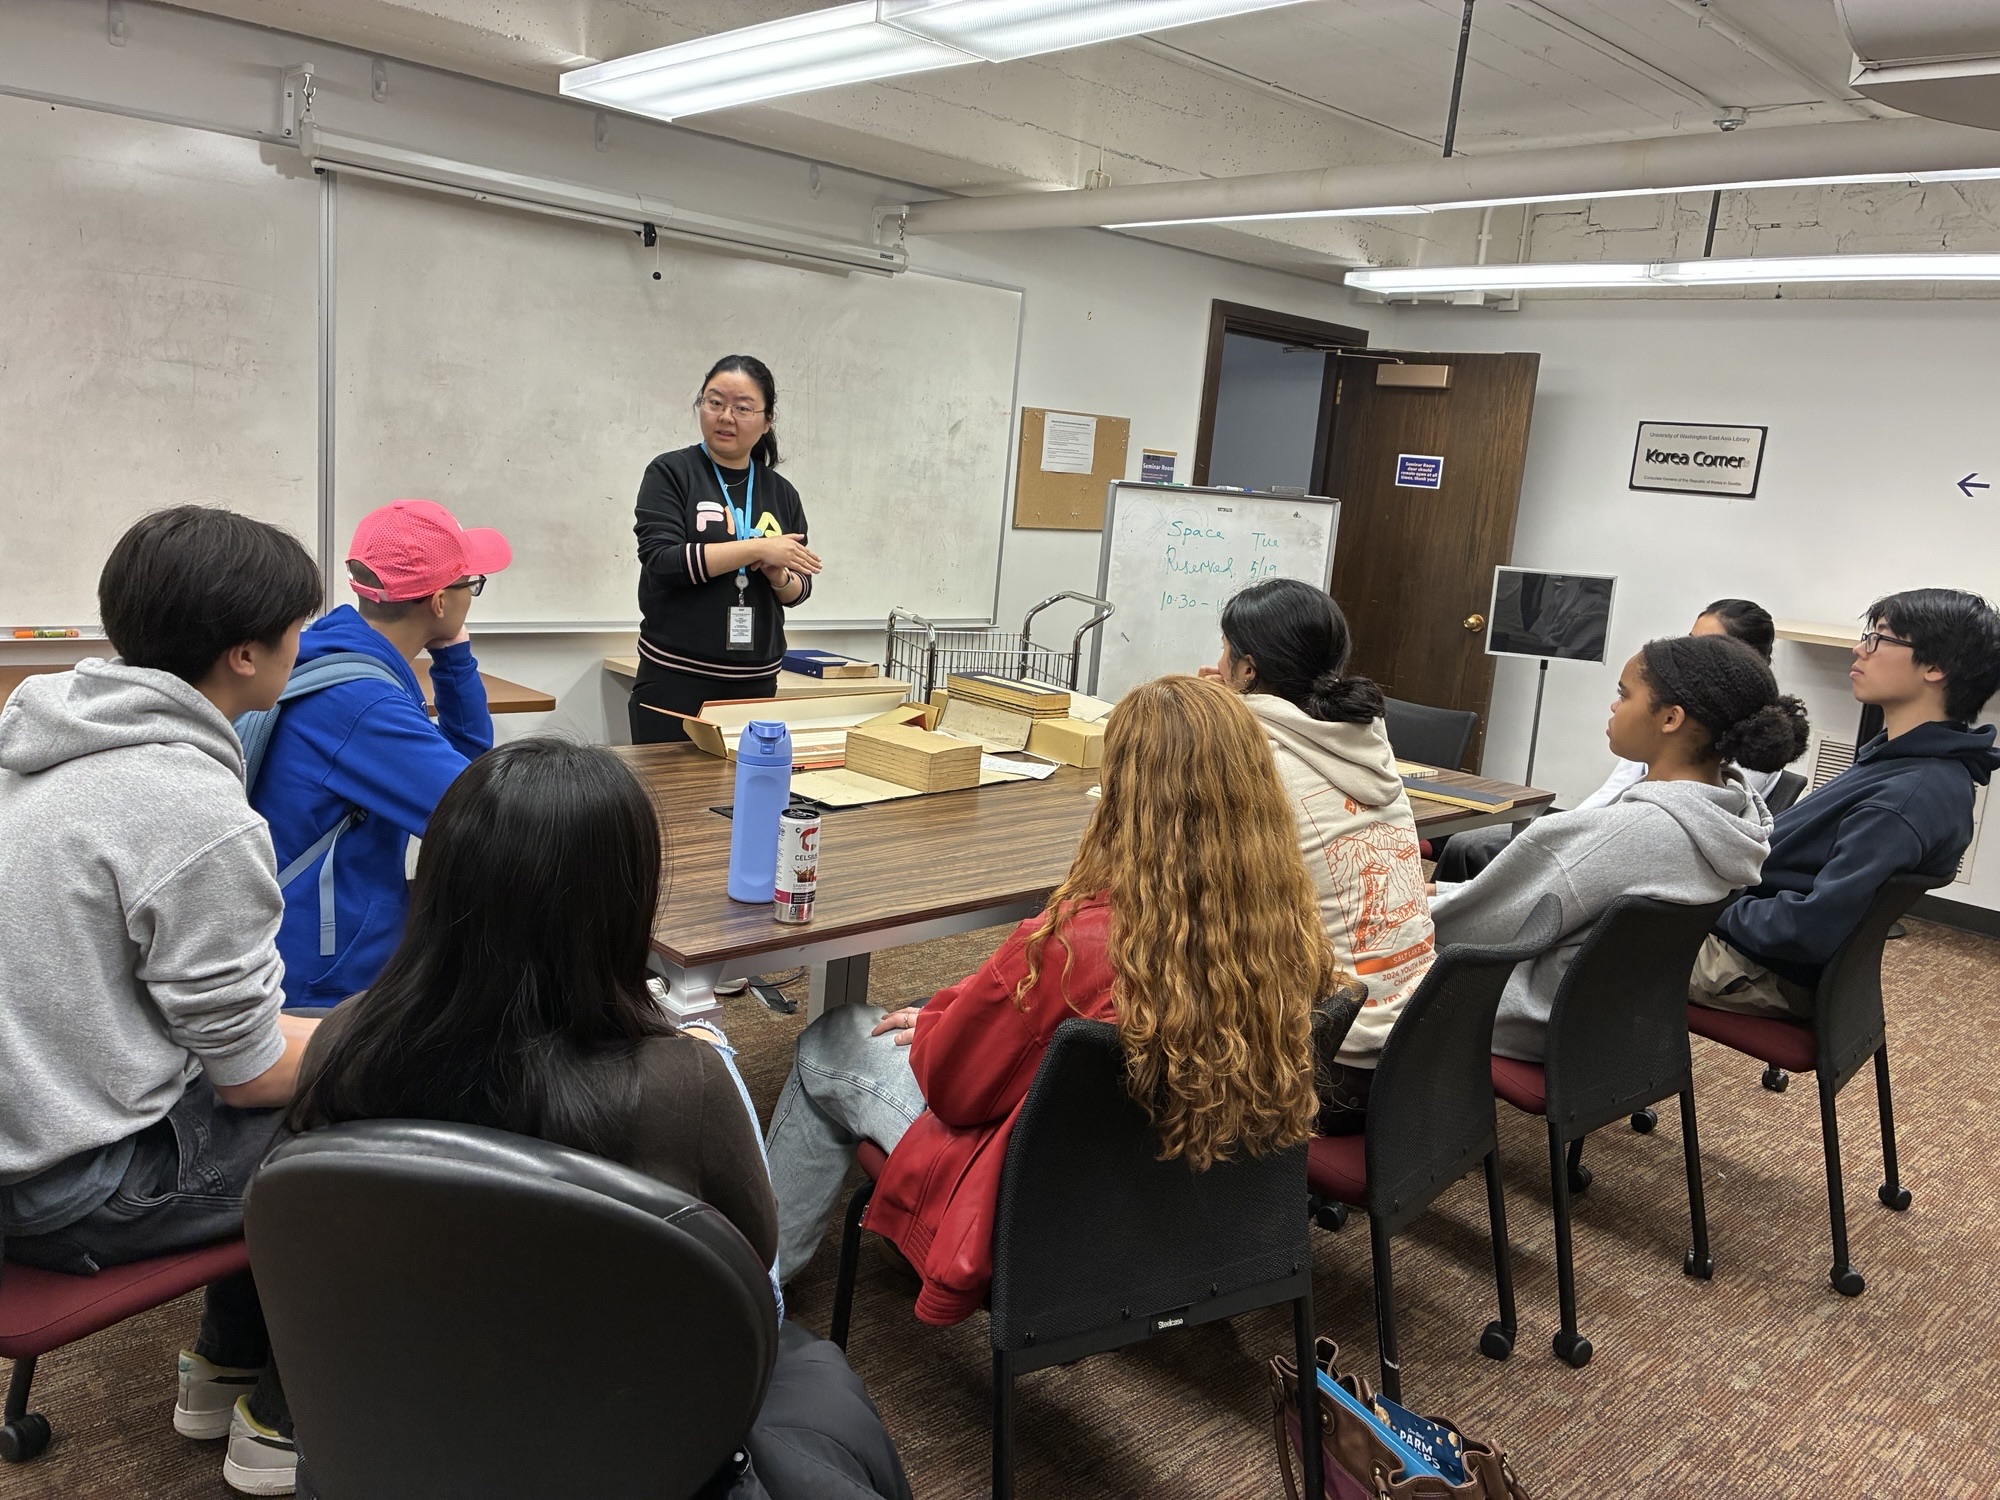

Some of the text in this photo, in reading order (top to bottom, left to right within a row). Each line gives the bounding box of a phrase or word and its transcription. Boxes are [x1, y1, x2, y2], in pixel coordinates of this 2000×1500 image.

[1142, 462, 1161, 470] Seminar
[1645, 448, 1745, 469] Korea Corner
[1167, 520, 1279, 551] Space Tue
[1249, 556, 1278, 579] 5/19
[1160, 591, 1196, 610] 10:30
[1393, 953, 1408, 964] SALT
[1408, 948, 1422, 957] LAKE
[1382, 970, 1400, 981] 2024
[1400, 963, 1419, 975] YOUTH
[1157, 1318, 1184, 1330] Steelcase
[1400, 1429, 1433, 1456] PARM
